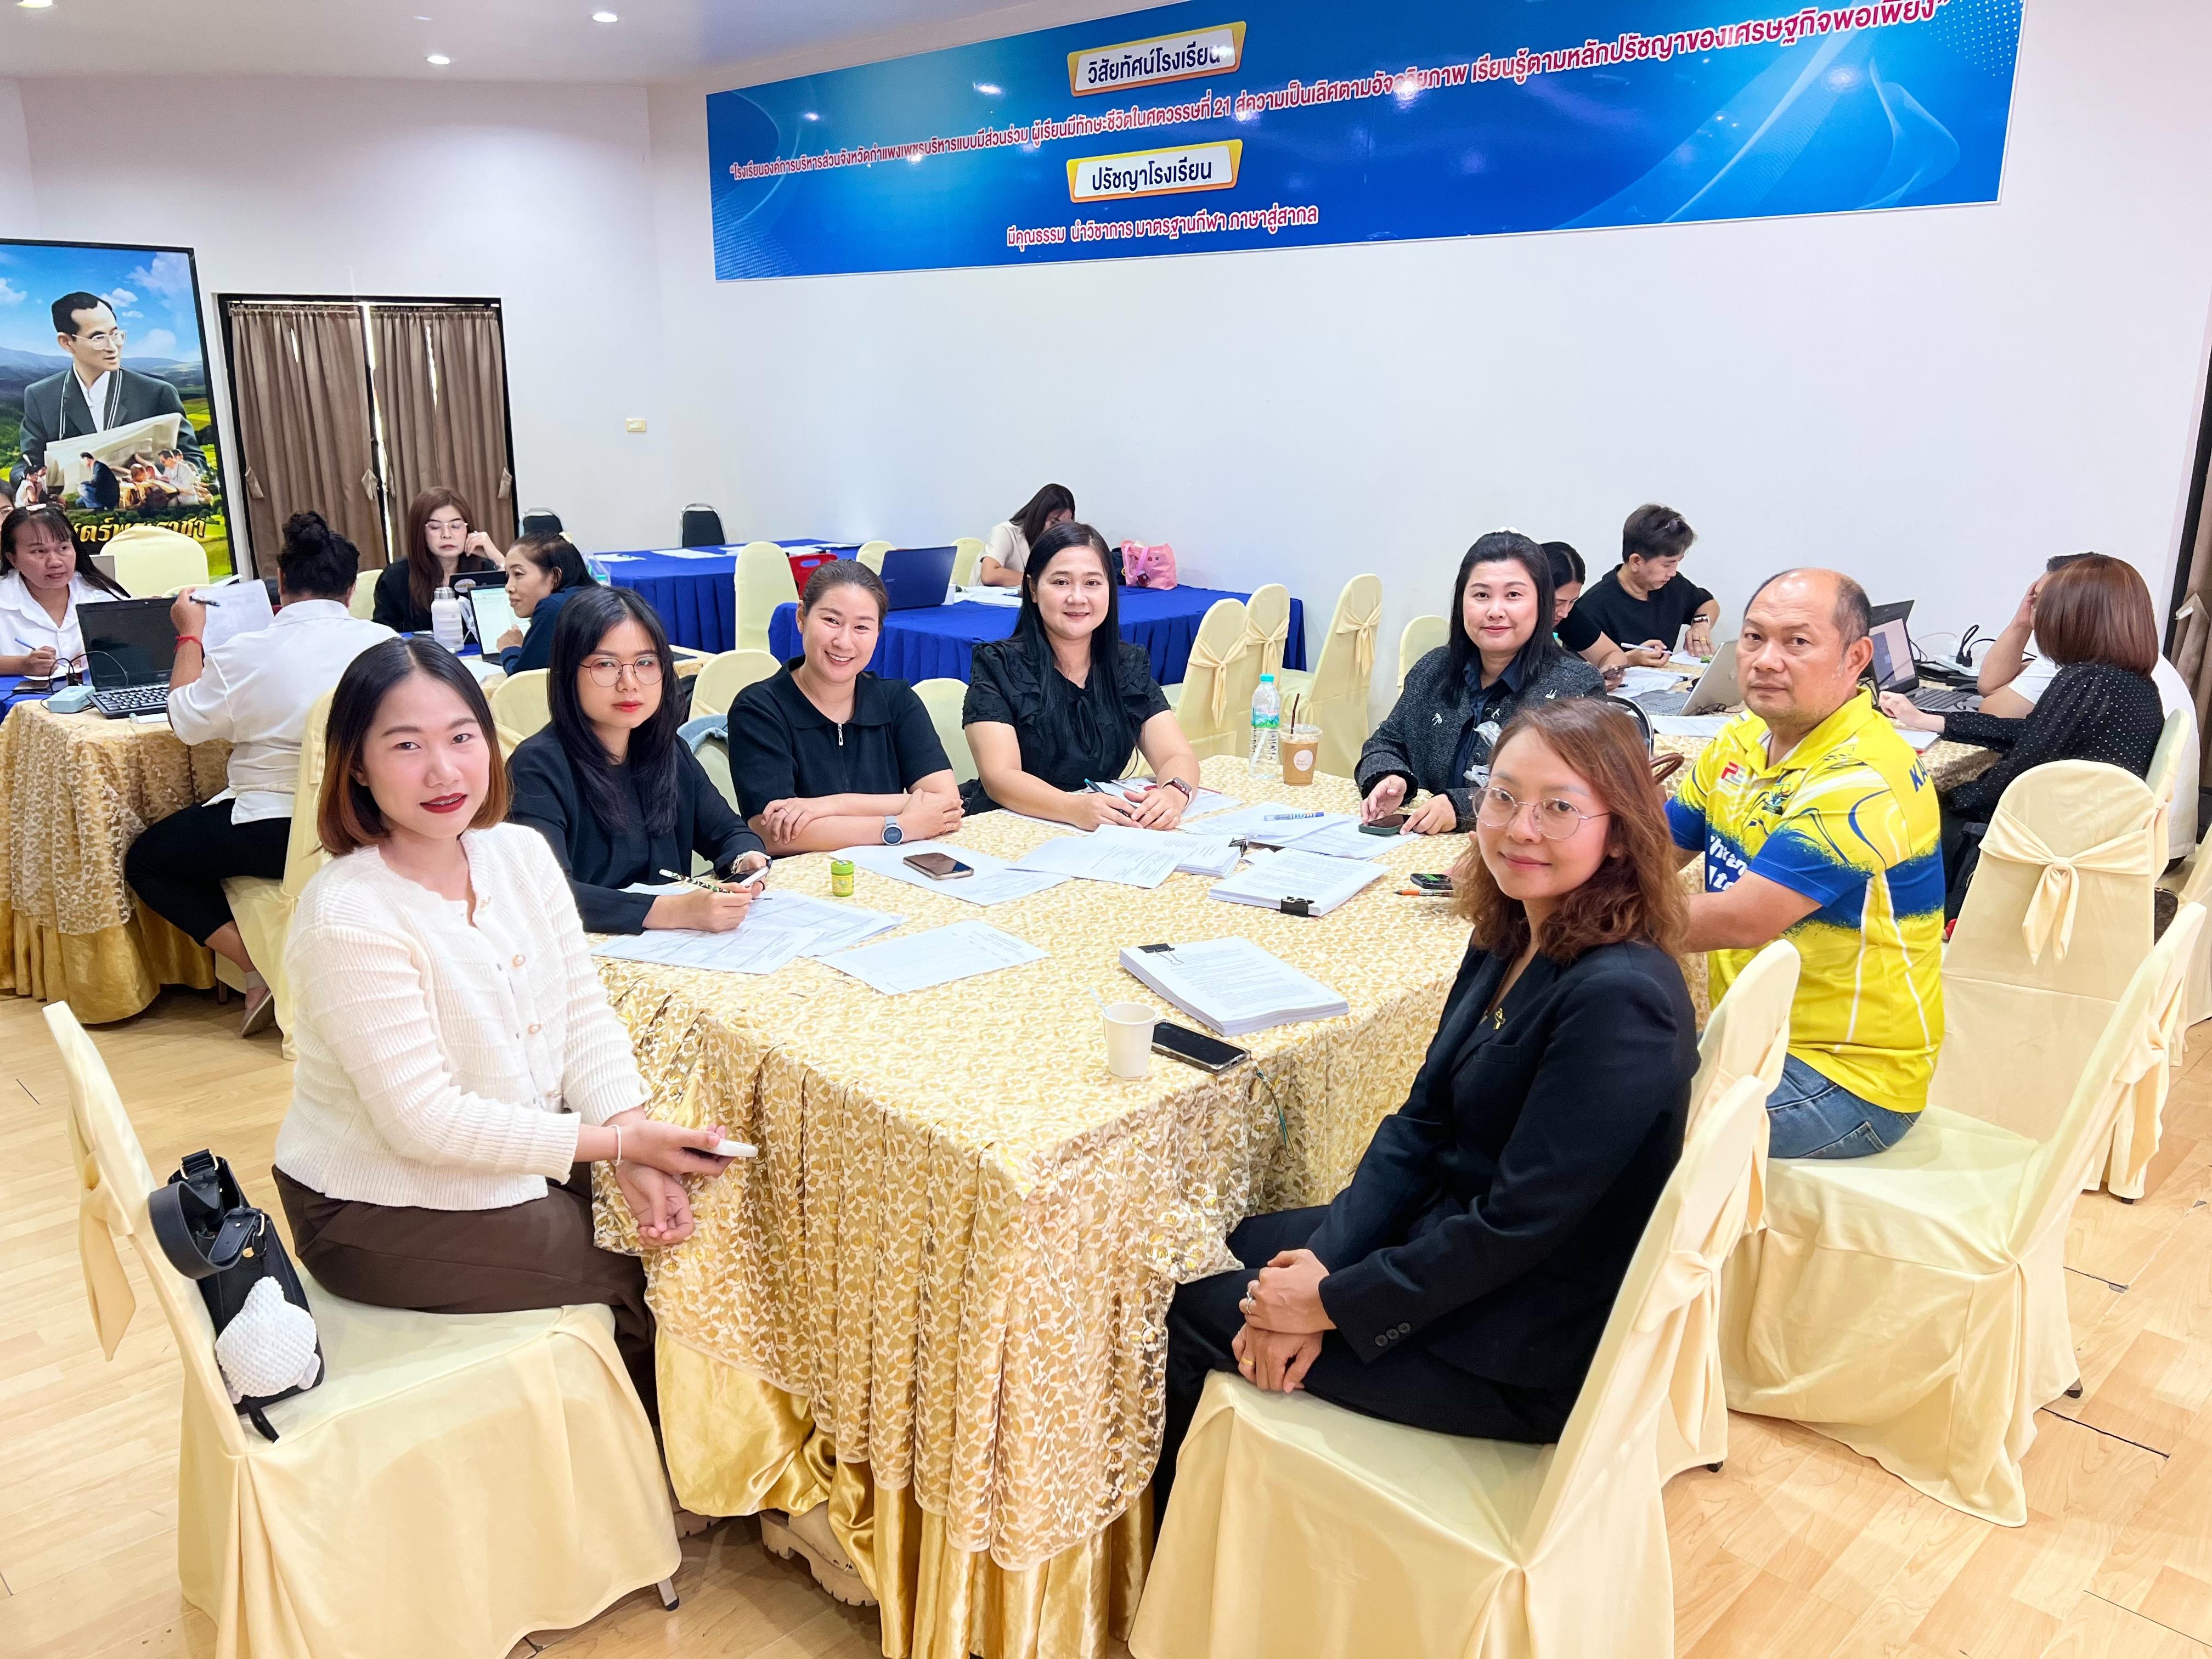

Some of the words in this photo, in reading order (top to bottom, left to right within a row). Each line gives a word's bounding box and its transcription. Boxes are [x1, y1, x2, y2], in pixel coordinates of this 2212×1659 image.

[1087, 41, 1221, 84] วิสัยทัศน์โรงเรียน
[1214, 97, 1231, 116] 21
[1092, 157, 1212, 191] ปรัชญาโรงเรียน
[1007, 226, 1065, 251] มีคุณธรรม
[1071, 220, 1132, 241] นำวิชาการ
[1136, 209, 1226, 238] มาตรฐานกีฬา
[1230, 204, 1318, 233] ภาษาสู่สากล
